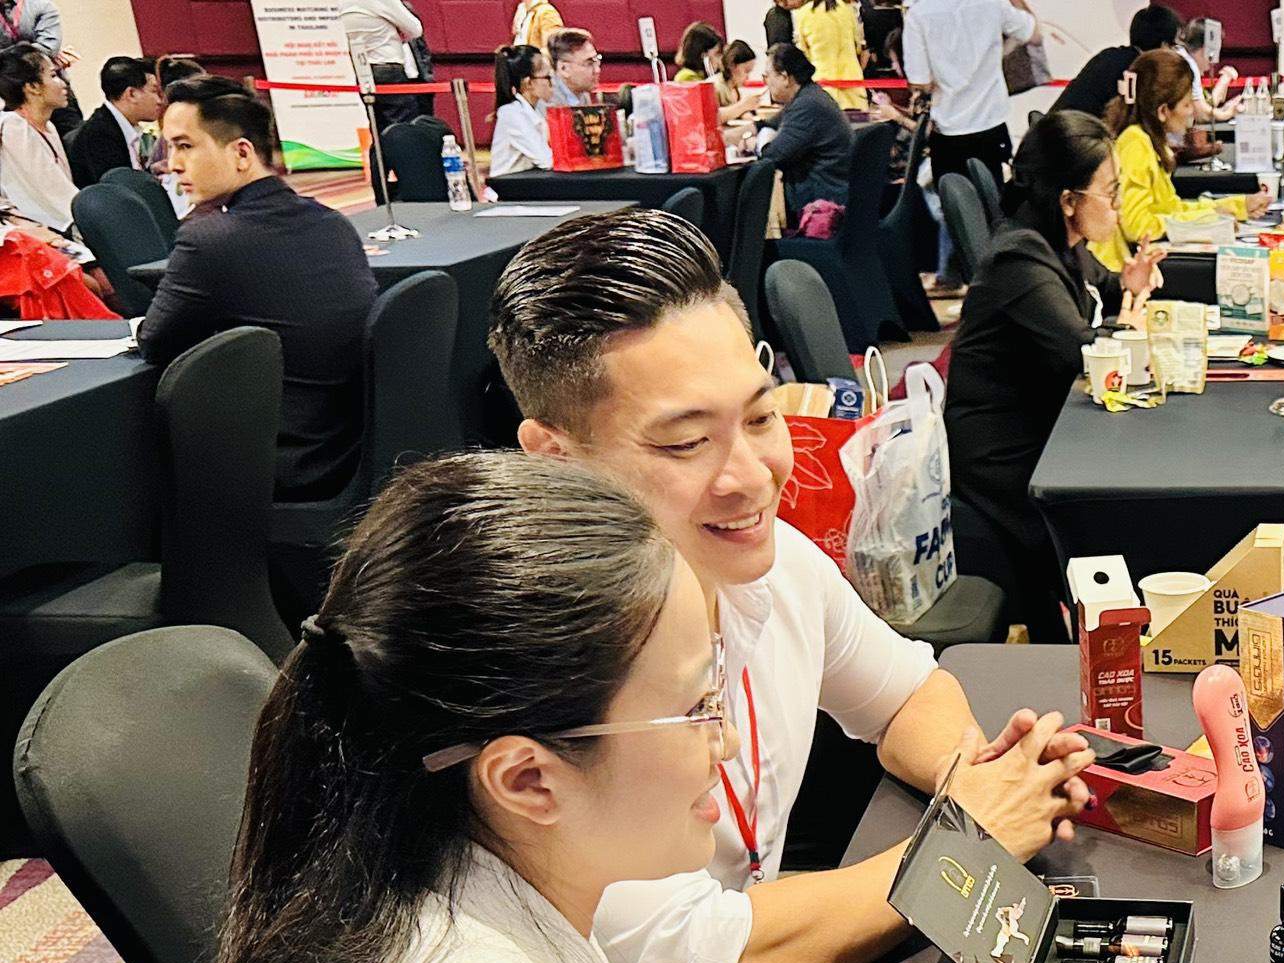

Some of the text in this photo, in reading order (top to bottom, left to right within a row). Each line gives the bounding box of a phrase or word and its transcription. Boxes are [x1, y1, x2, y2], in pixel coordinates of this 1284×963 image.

[1152, 649, 1207, 666] 15 PACKETS
[1098, 671, 1116, 680] CAO
[1235, 727, 1249, 748] XOA
[1241, 751, 1254, 773] CAO
